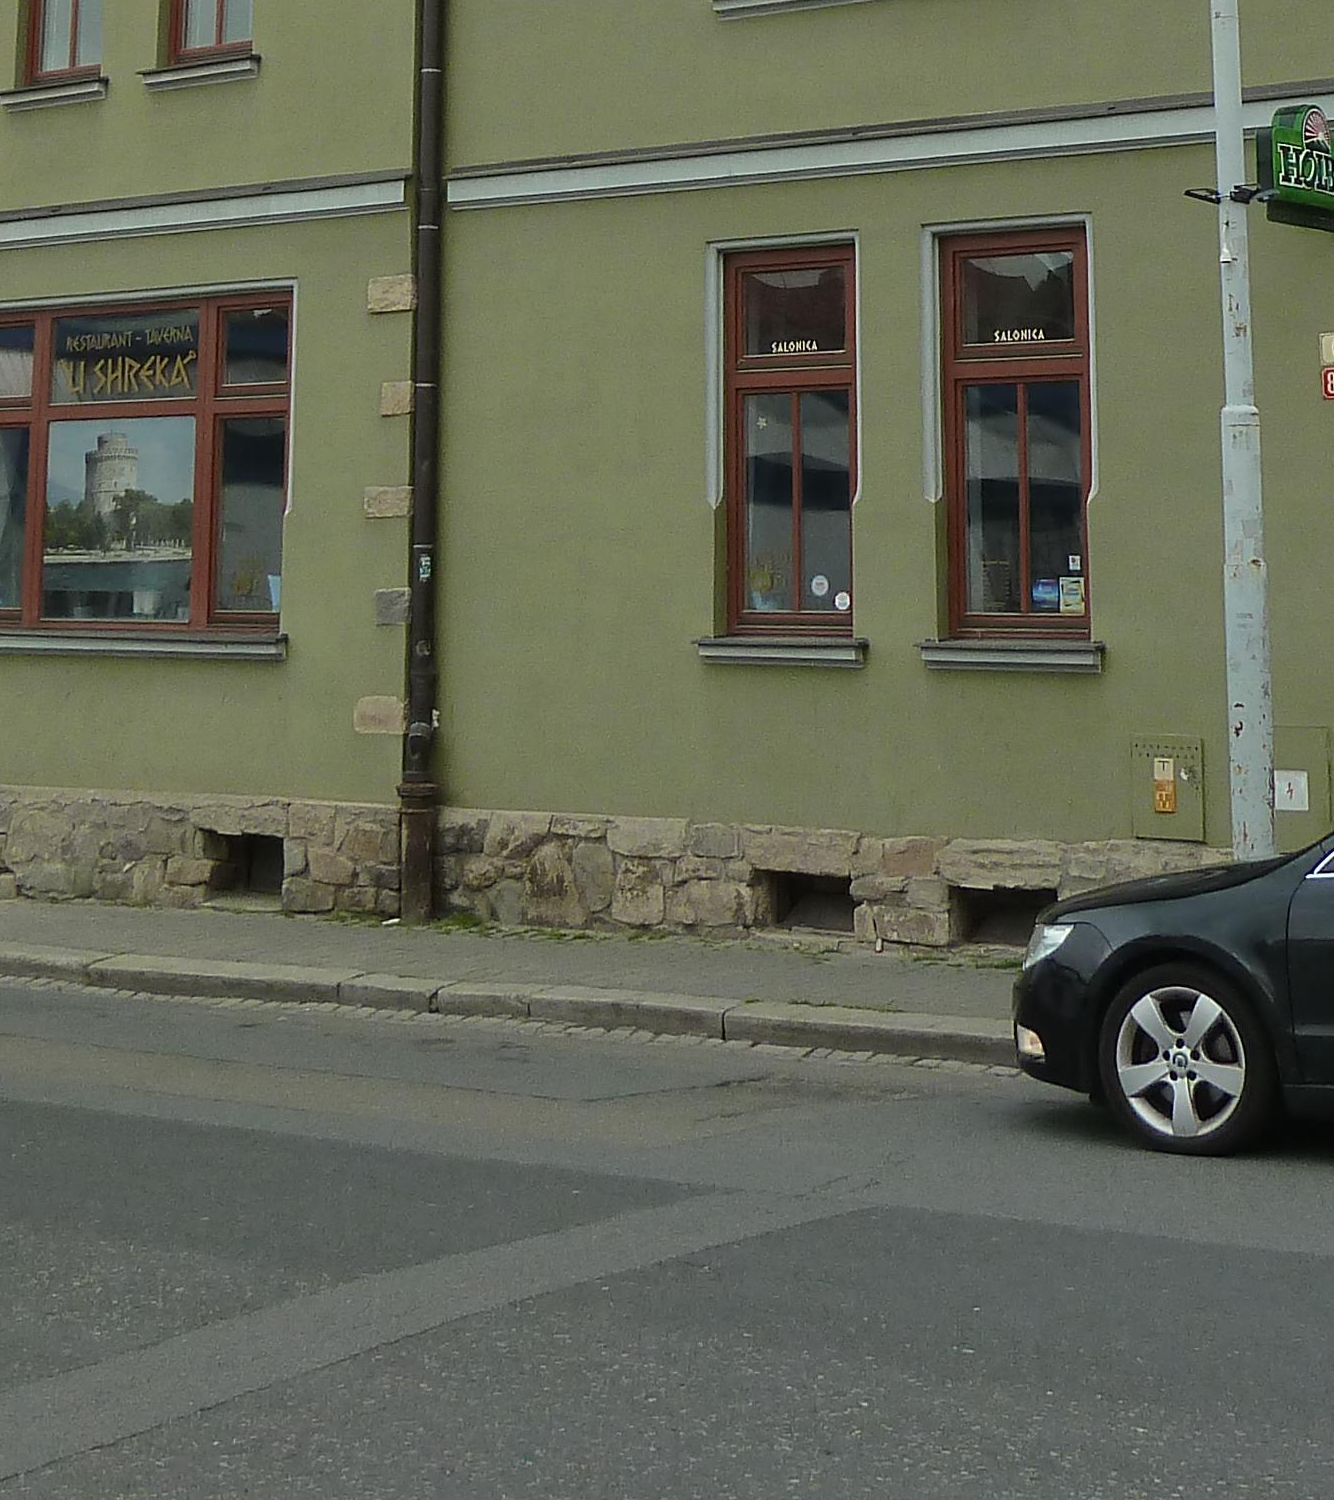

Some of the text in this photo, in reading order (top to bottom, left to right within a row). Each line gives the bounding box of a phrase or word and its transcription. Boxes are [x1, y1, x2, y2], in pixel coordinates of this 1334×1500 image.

[66, 331, 134, 352] RESTAURANT
[145, 325, 194, 345] TAVERNA
[993, 328, 1046, 342] SALONICA
[770, 339, 819, 353] SALONICA
